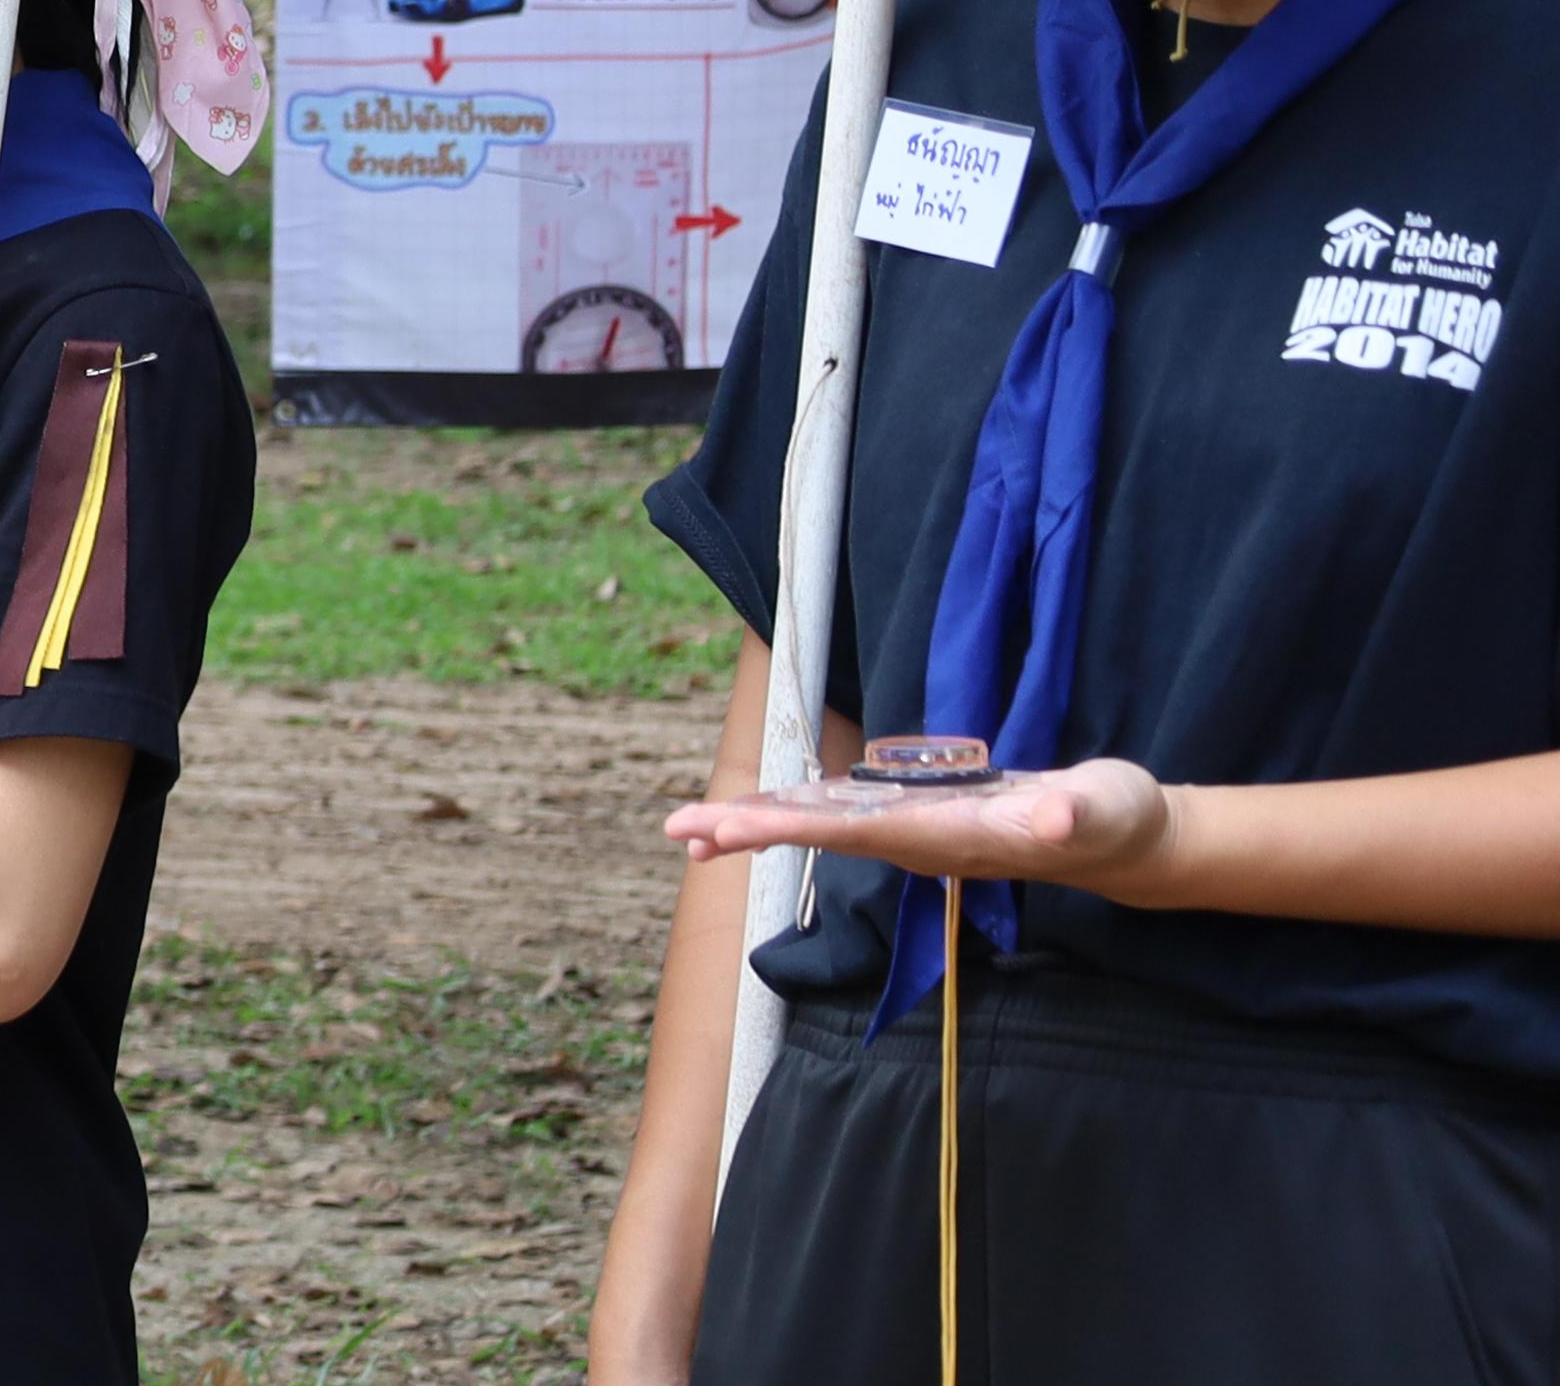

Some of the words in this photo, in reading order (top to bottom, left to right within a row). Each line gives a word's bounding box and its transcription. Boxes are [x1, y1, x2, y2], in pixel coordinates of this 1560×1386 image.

[907, 126, 1001, 183] ธนัญญา
[914, 182, 968, 225] ไก่ฟ้า
[1390, 257, 1415, 275] for
[1416, 258, 1493, 289] Humanity
[1394, 228, 1499, 269] Habitat
[1289, 276, 1420, 335] HABITAT
[1418, 287, 1502, 364] HERO
[1280, 325, 1483, 392] 2014
